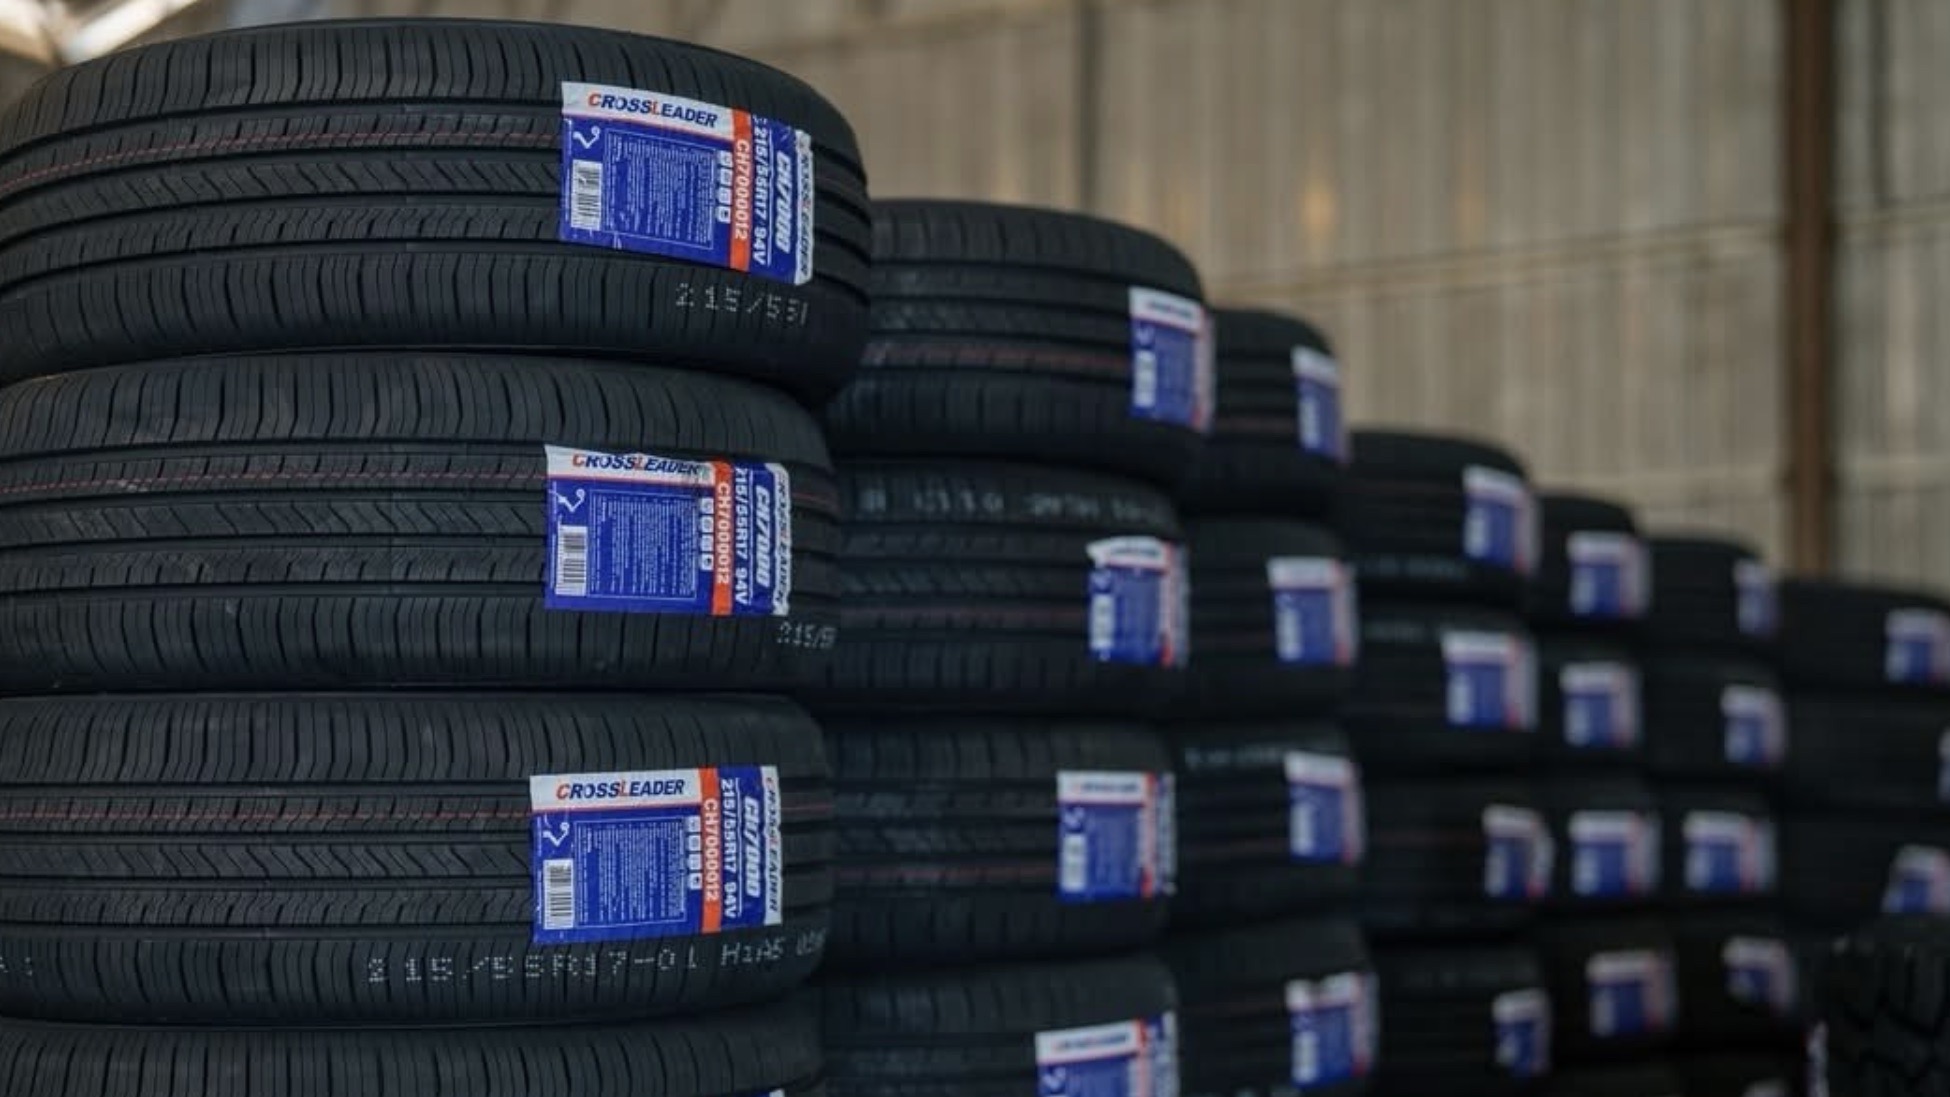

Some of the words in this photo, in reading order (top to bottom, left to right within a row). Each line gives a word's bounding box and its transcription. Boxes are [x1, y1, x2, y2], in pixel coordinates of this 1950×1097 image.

[587, 93, 718, 129] CROSSLEADER
[735, 138, 750, 241] CH7000012
[572, 454, 700, 476] CROSSLEADER
[717, 482, 731, 585] CH7000012
[735, 566, 748, 605] 94V
[556, 779, 685, 800] CROSSLEADER
[704, 799, 719, 902] CH7000012
